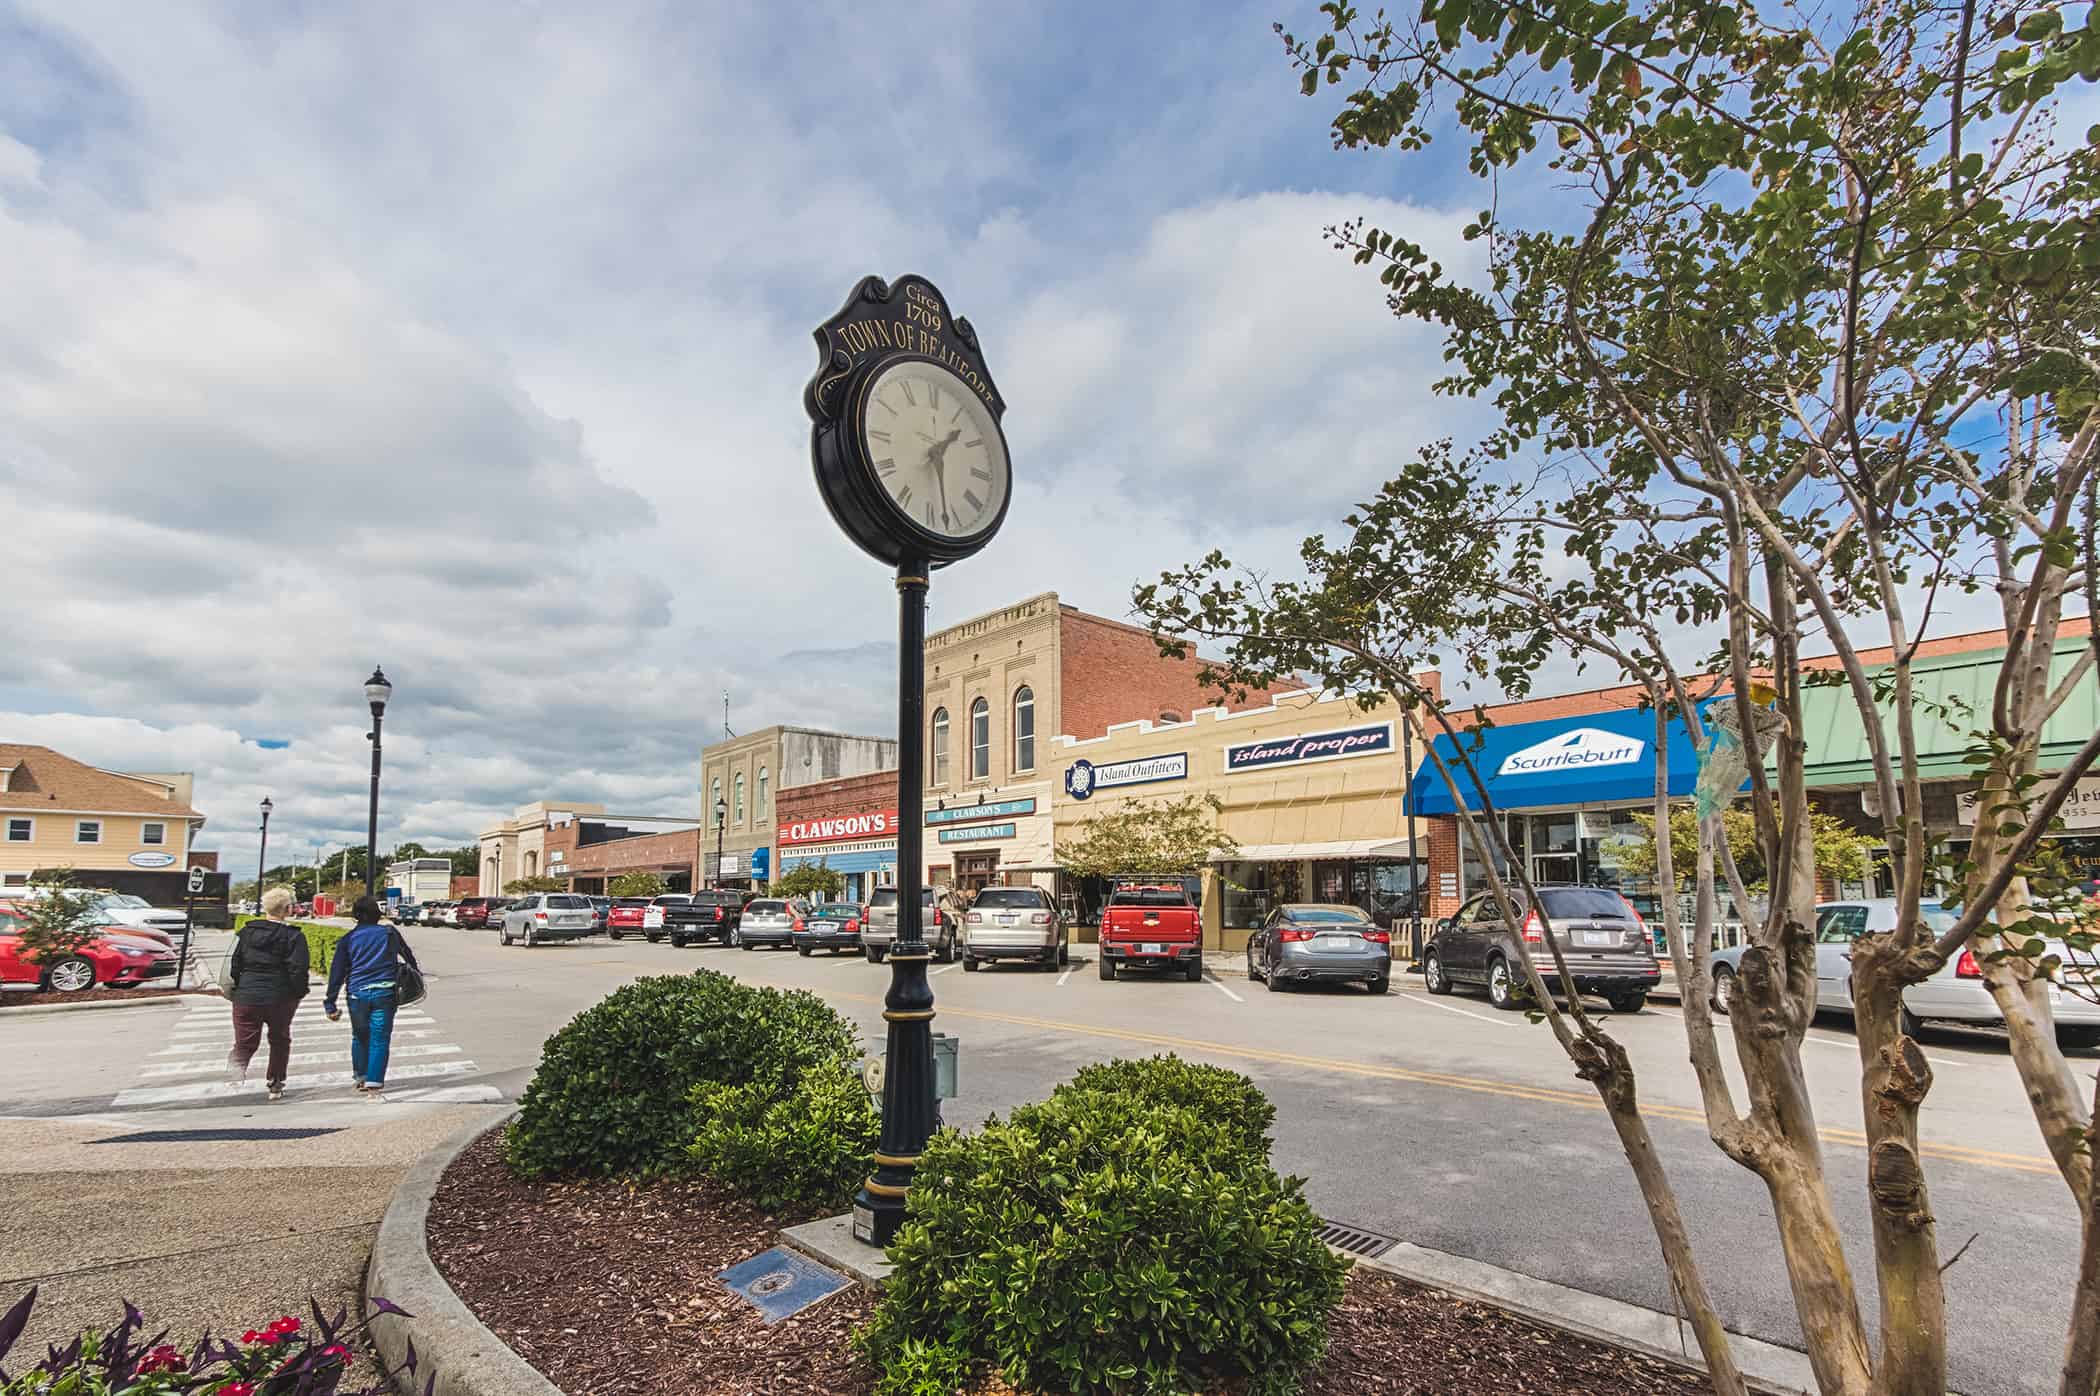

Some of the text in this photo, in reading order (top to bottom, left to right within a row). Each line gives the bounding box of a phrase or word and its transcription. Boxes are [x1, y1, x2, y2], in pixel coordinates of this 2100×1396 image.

[906, 284, 940, 312] Circa
[905, 302, 942, 332] 1709
[837, 319, 893, 354] TOWN
[894, 321, 914, 350] OF
[1233, 733, 1384, 763] island proper
[1507, 747, 1633, 770] Scuttlebutt
[1100, 760, 1183, 781] Island Outfitters
[790, 813, 886, 840] CLAWSON'S
[947, 826, 1005, 841] RESTAURANT
